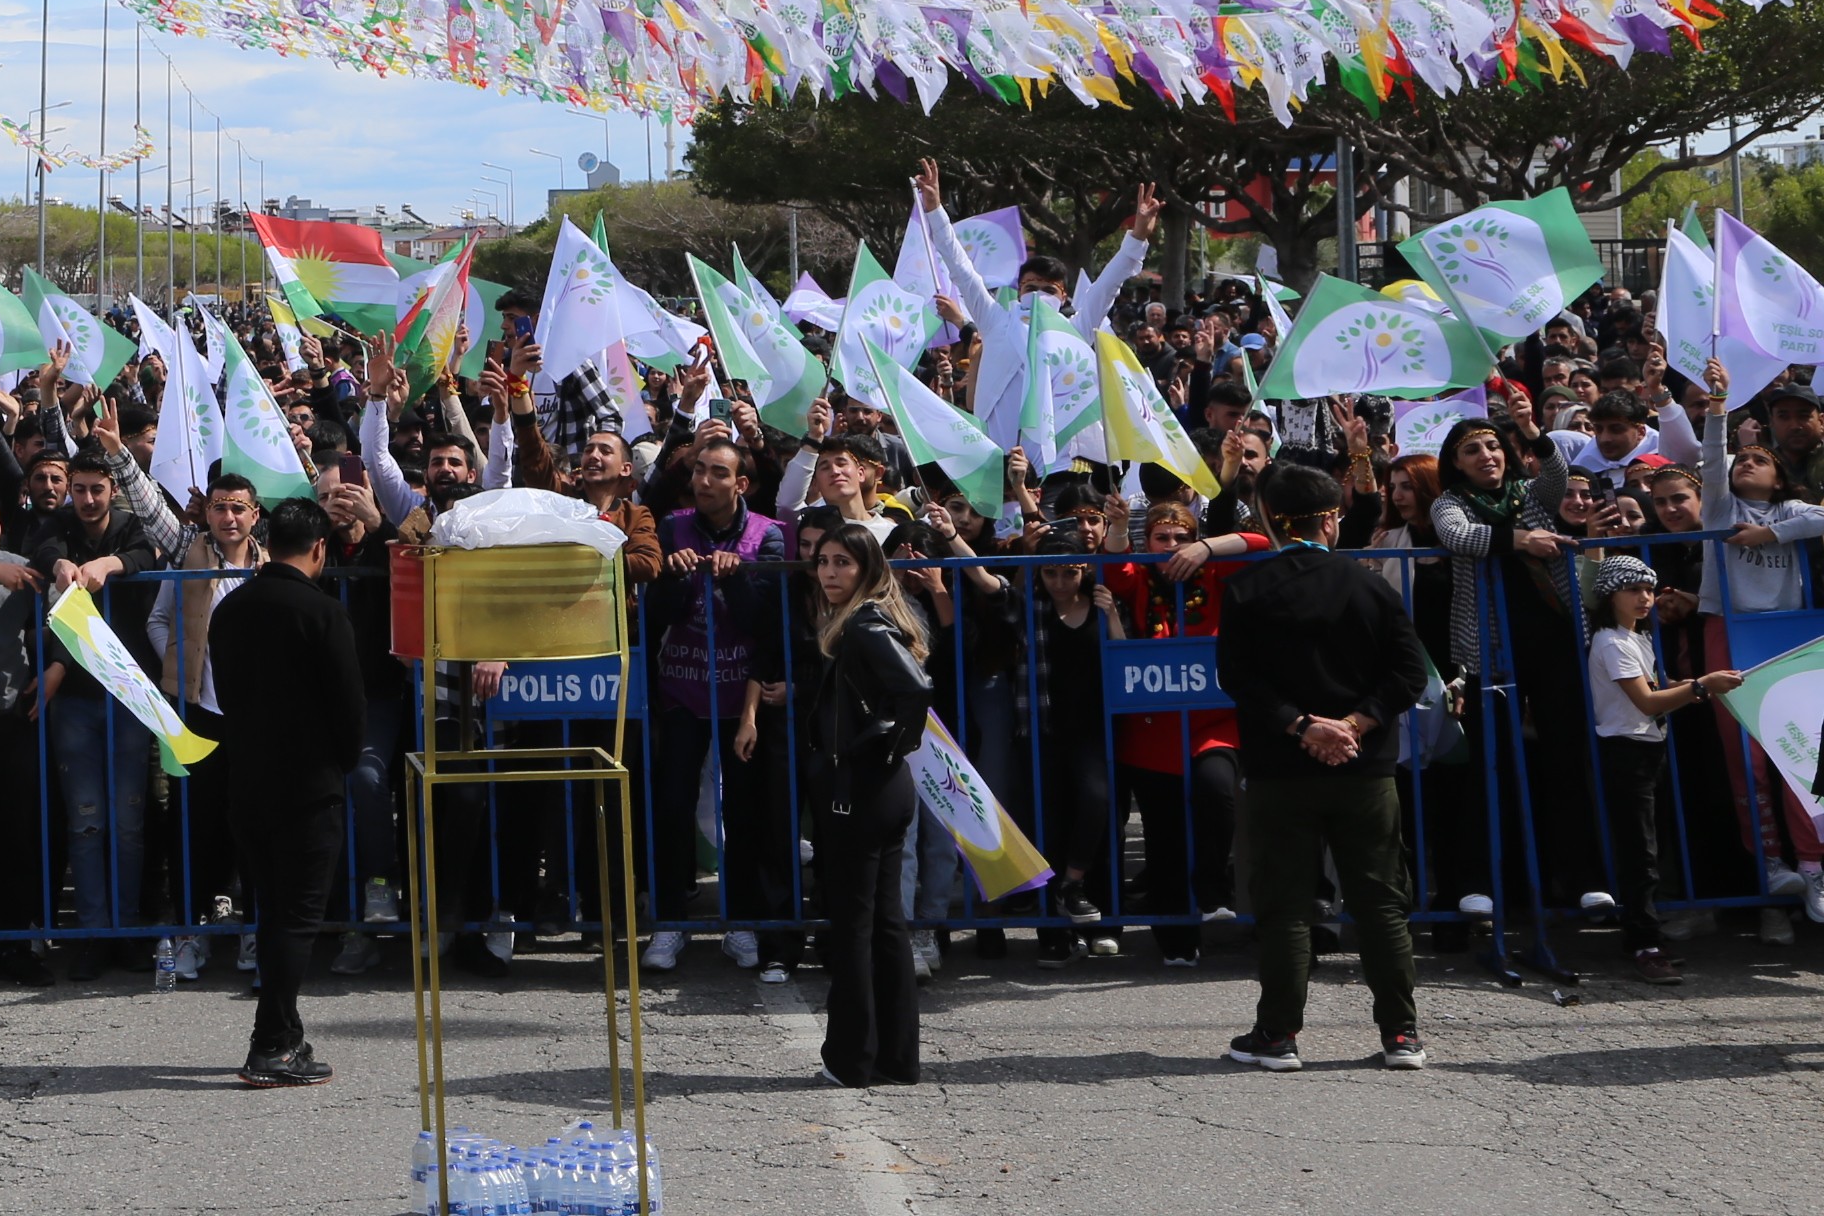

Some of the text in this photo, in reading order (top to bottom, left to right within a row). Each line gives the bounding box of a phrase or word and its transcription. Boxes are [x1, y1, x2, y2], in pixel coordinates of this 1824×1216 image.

[1772, 322, 1824, 339] YEŞİL SO
[1780, 340, 1817, 353] PARTİ
[591, 673, 620, 701] 07
